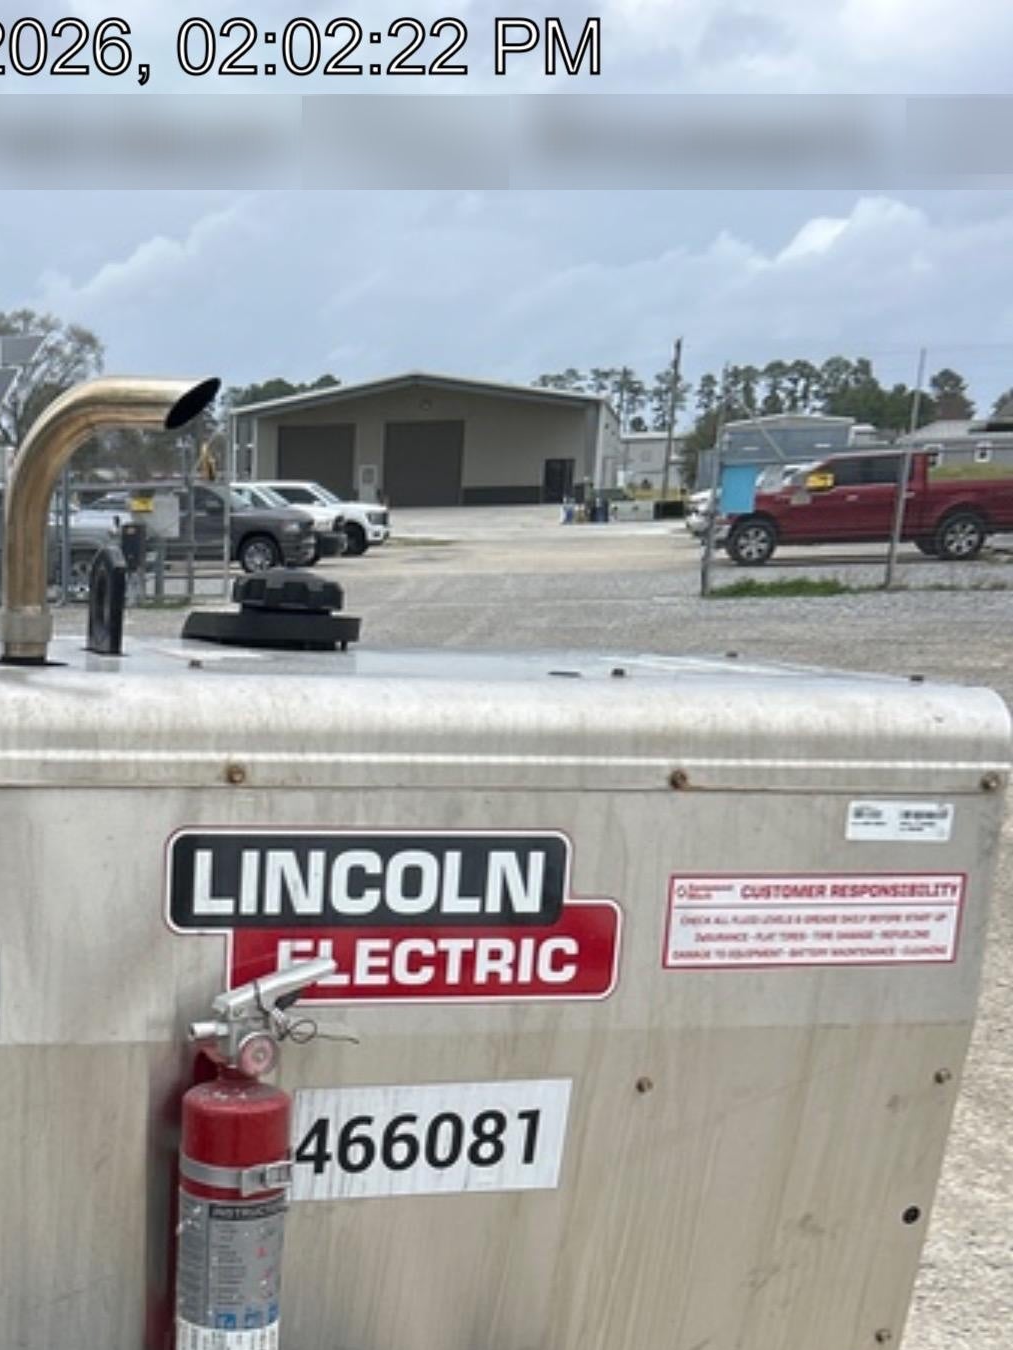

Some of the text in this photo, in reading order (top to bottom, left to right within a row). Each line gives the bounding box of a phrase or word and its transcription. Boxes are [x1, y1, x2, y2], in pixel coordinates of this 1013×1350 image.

[192, 849, 547, 916] LINCOLN
[739, 882, 958, 899] CUSTOMER RESPONSIBILITY
[276, 936, 581, 986] ELECTRIC
[294, 1108, 542, 1176] 466081
